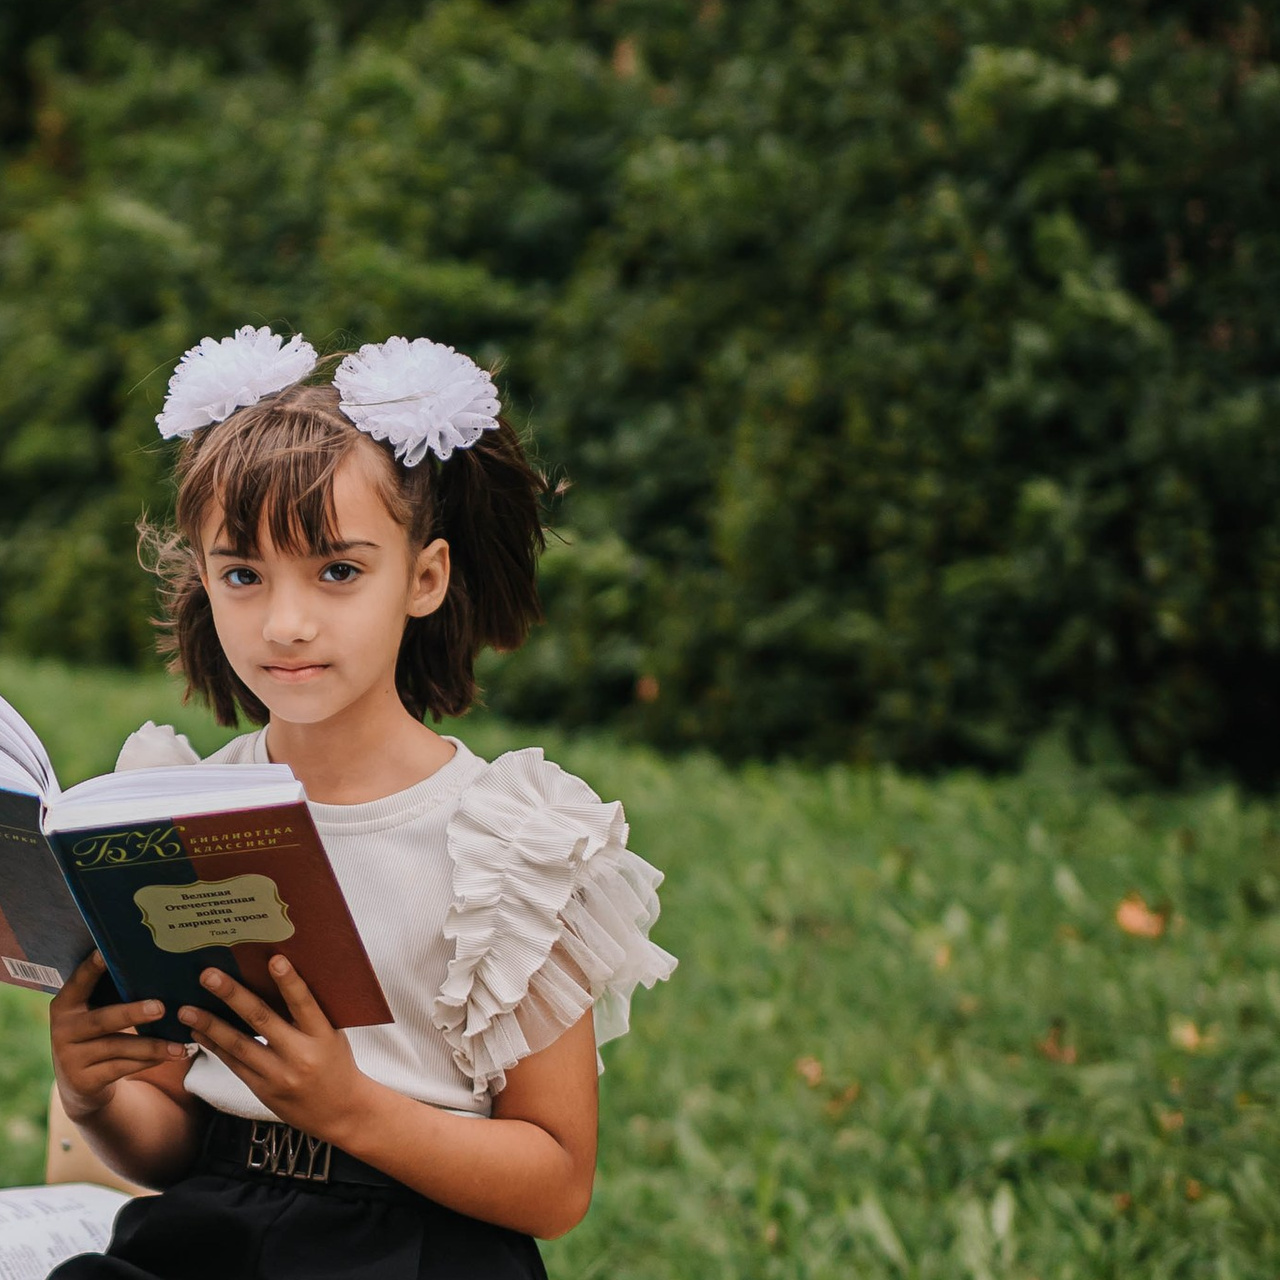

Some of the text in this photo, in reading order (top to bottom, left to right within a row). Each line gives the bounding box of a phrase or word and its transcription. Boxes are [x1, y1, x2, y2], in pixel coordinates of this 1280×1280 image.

[189, 826, 294, 844] БИБЛИОТЕКА
[193, 838, 278, 853] КЛАССИКИ
[180, 889, 231, 900] Великая
[165, 896, 255, 912] Отечественная
[196, 907, 233, 917] война
[177, 918, 221, 929] лирике
[234, 912, 269, 924] прозе
